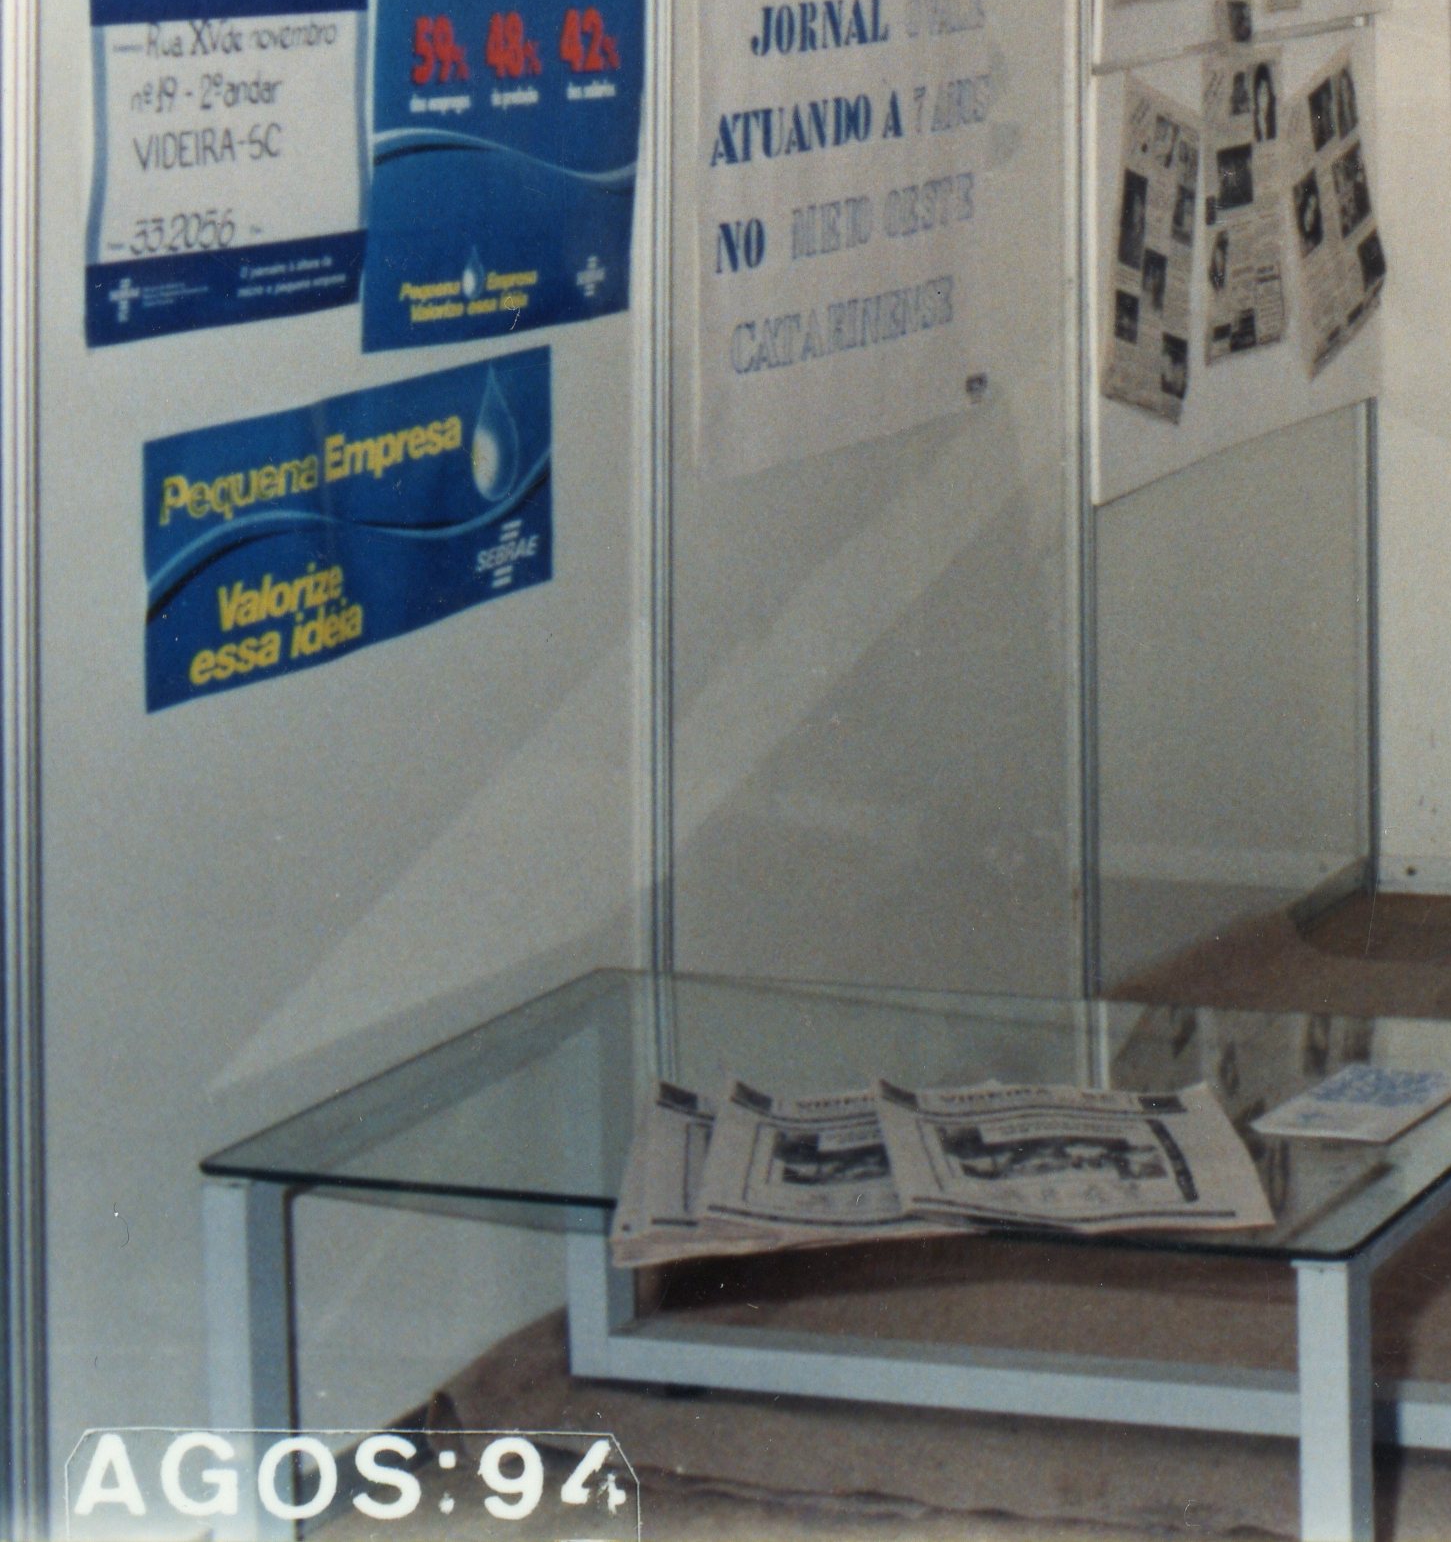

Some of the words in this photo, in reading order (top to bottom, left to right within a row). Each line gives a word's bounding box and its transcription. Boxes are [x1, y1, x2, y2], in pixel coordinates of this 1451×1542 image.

[709, 93, 872, 167] ATUANDO
[715, 217, 766, 274] NO
[159, 453, 319, 527] Pequena
[324, 414, 463, 483] Empresa
[475, 533, 540, 575] SEBRAE
[217, 561, 345, 632] Valorize
[189, 630, 282, 686] essa
